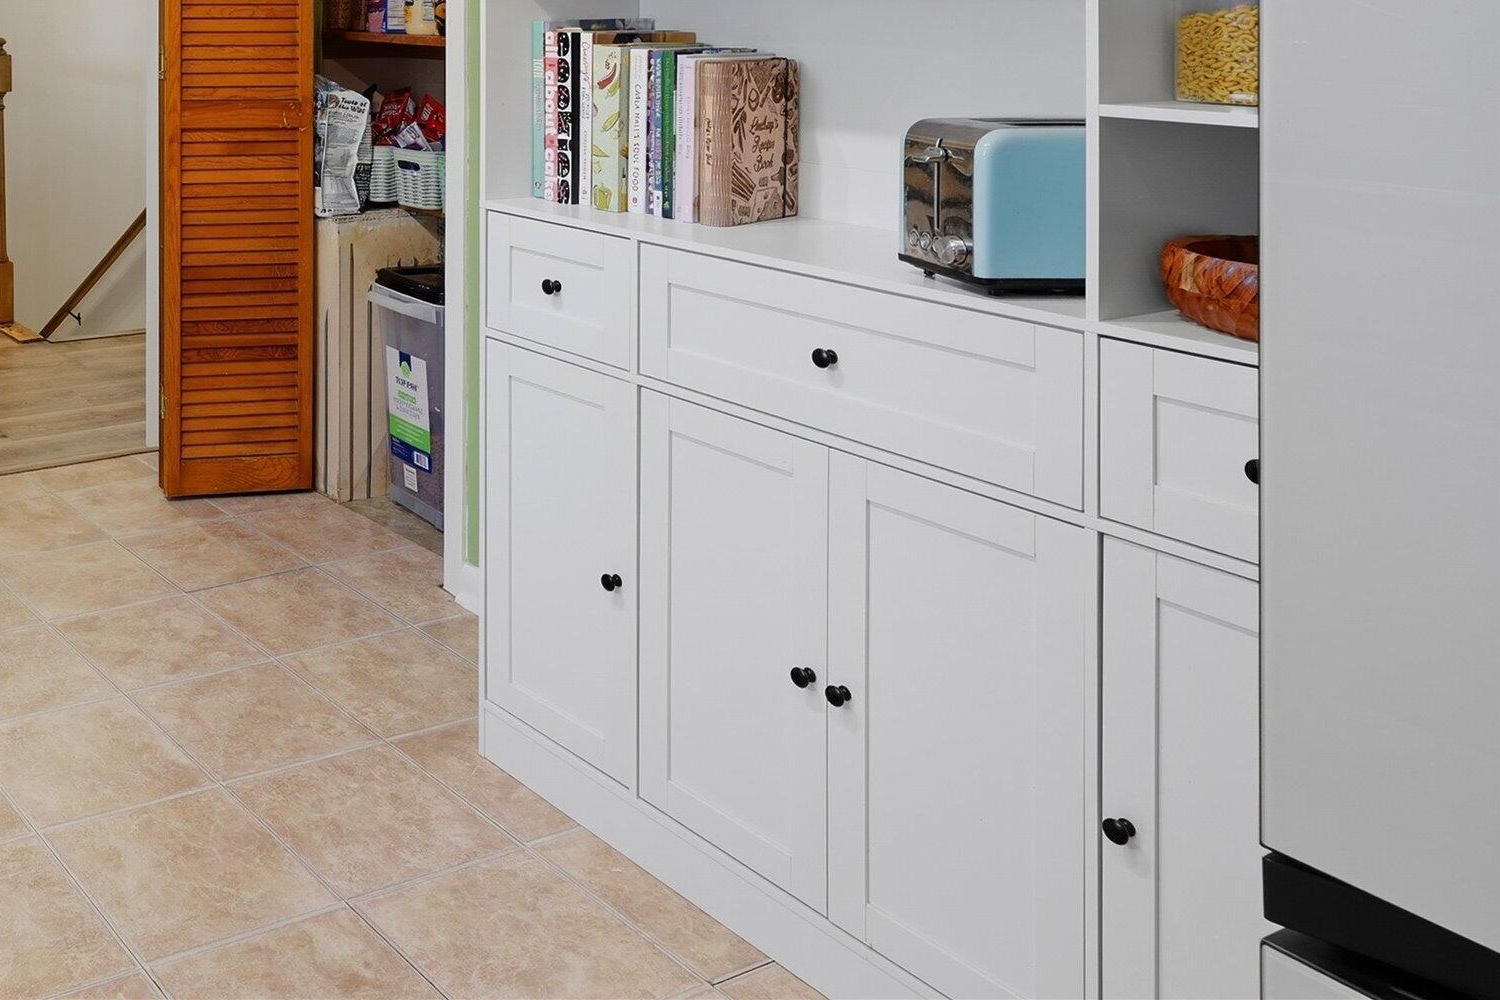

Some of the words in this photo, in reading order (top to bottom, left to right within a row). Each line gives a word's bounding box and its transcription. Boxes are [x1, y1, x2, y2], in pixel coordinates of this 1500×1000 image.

[633, 83, 642, 110] CARLA
[632, 142, 641, 164] SOUL
[631, 166, 640, 192] FOOD
